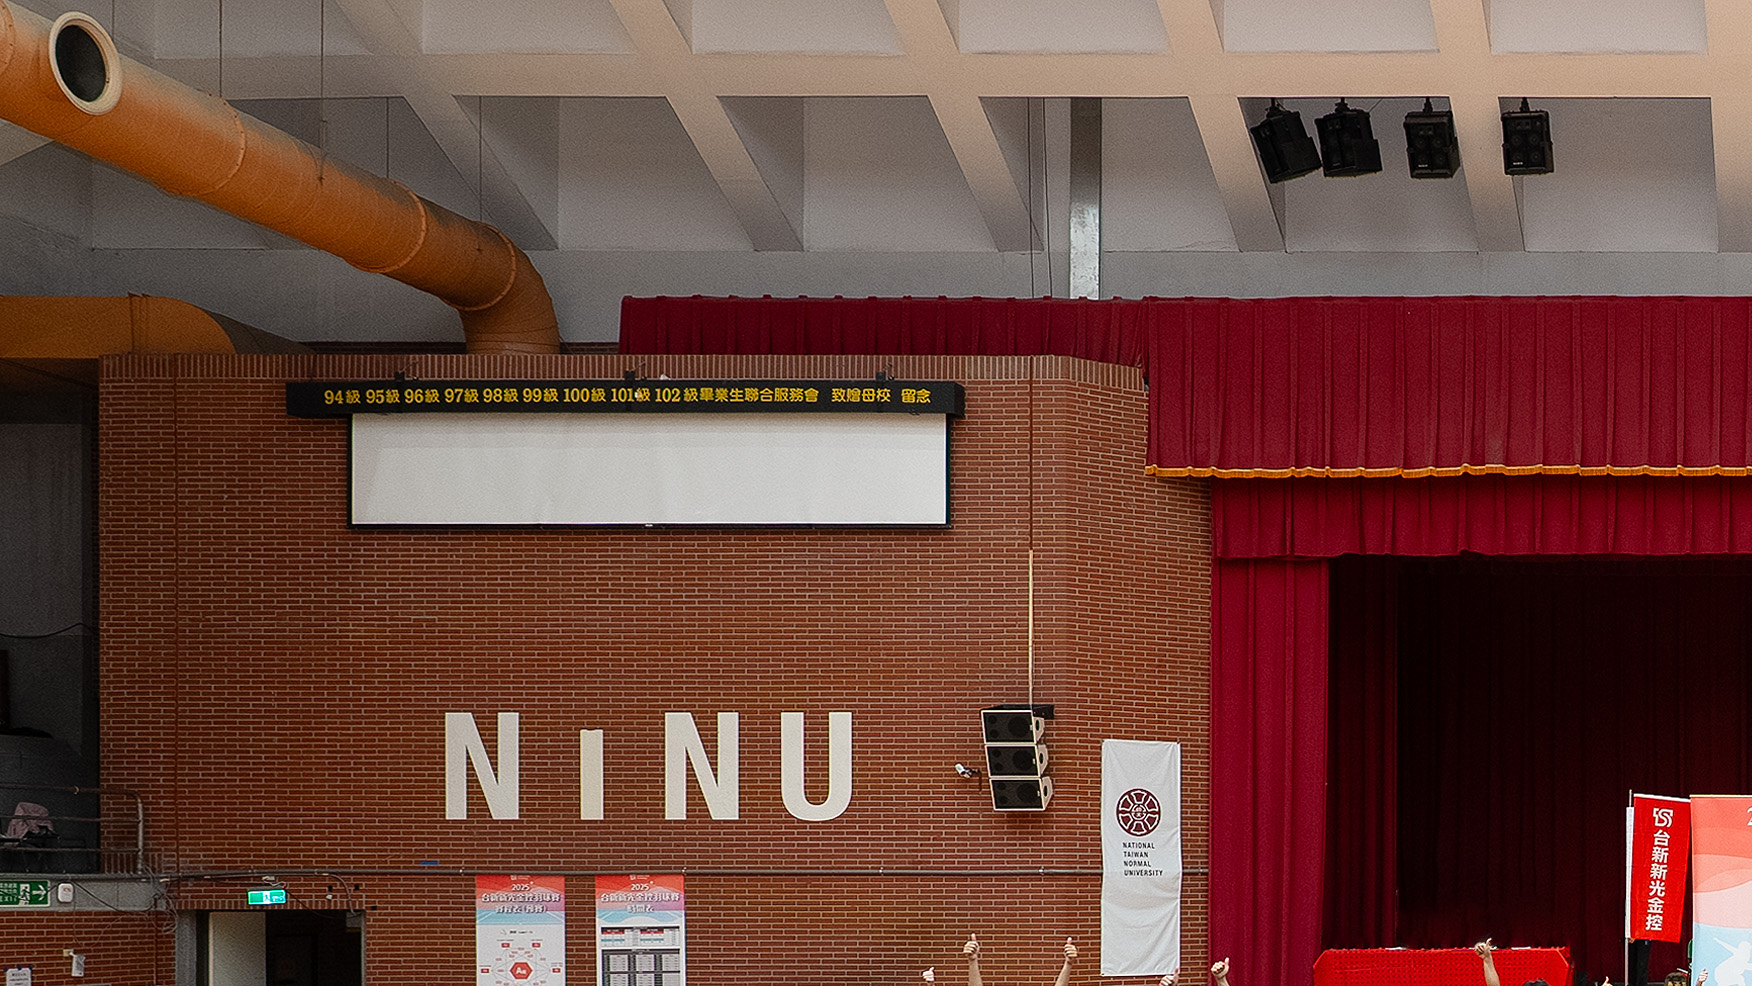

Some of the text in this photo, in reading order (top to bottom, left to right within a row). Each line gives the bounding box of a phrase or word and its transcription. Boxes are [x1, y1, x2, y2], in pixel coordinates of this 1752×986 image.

[324, 389, 361, 404] 94級
[366, 389, 400, 404] 95級
[404, 388, 440, 403] 96級
[444, 388, 479, 403] 97級
[483, 388, 519, 402] 98級
[523, 388, 559, 402] 99級
[563, 387, 606, 402] 100級
[901, 388, 931, 403] 留念
[1645, 829, 1671, 932] 台新新光金控
